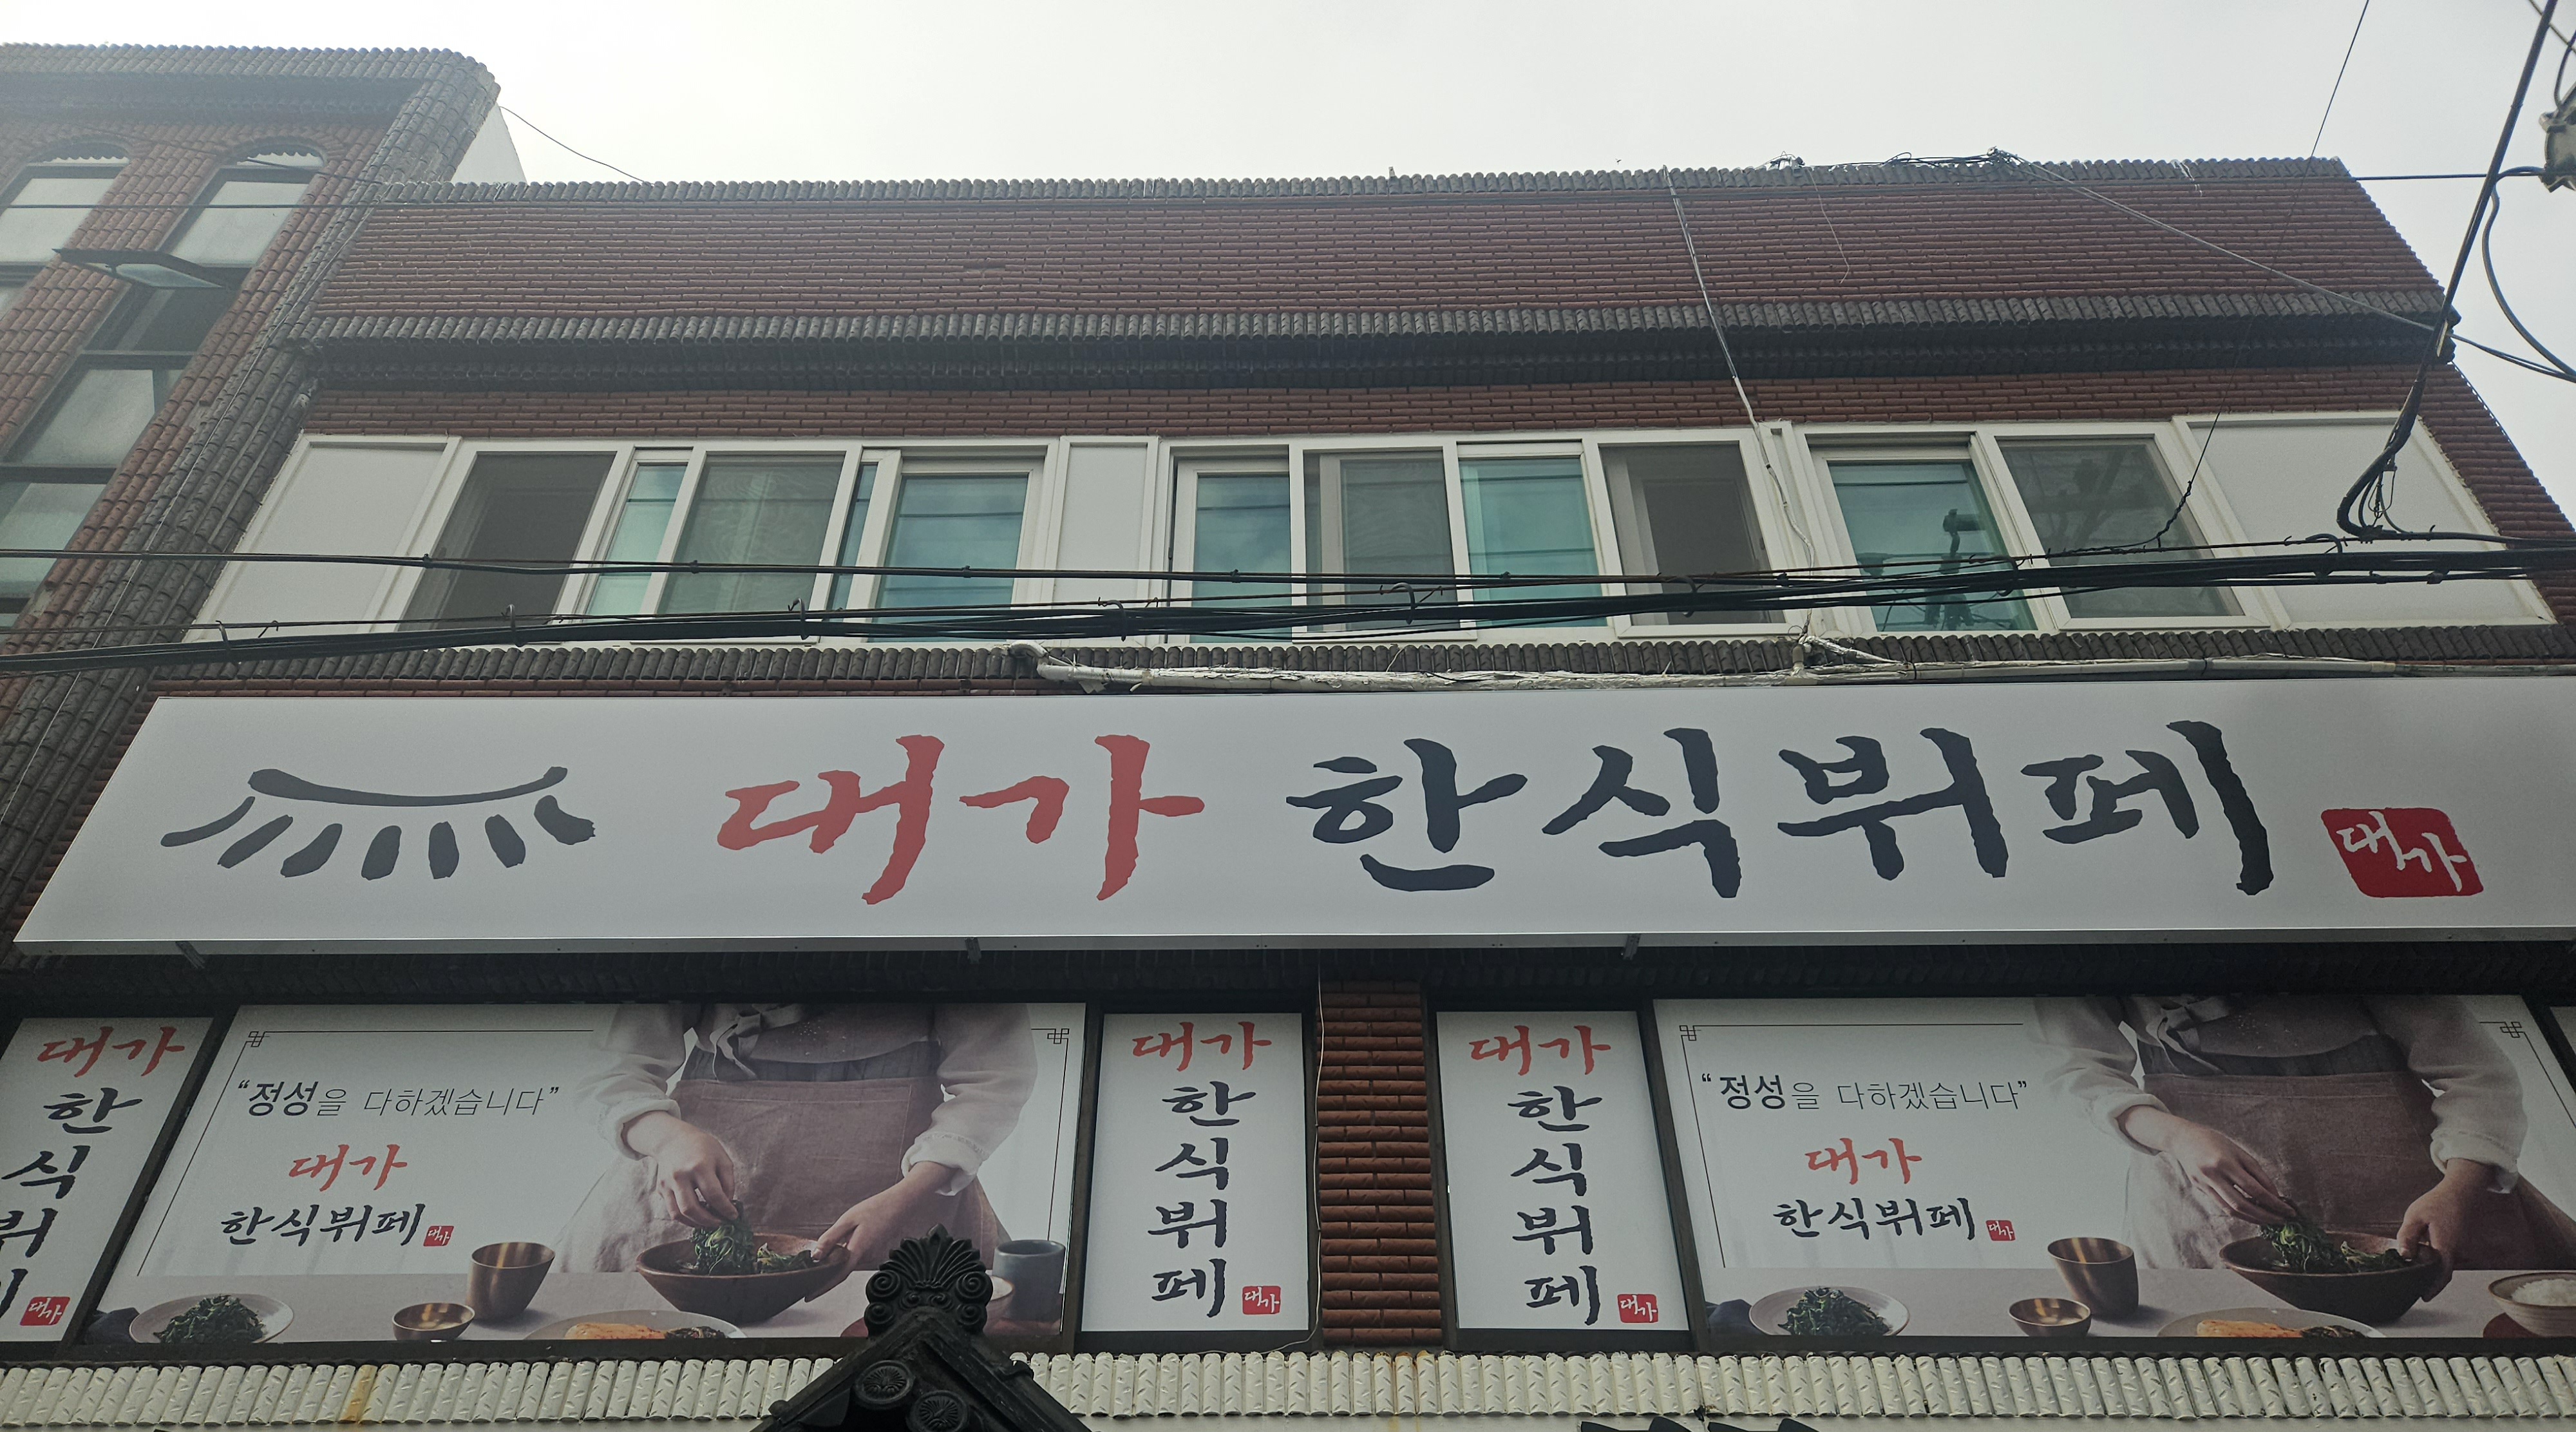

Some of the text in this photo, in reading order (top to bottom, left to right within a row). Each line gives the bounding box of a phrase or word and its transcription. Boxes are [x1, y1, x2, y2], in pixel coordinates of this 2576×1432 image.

[717, 720, 2275, 905] 대가 한식뷔페
[2336, 811, 2467, 892] 대가
[37, 1026, 185, 1078] 대가
[1132, 1021, 1272, 1072] 대가
[1469, 1024, 1611, 1076] 대가
[364, 1086, 560, 1116] 다하겠습니다”
[1837, 1080, 2027, 1110] 다하겠습니다”
[289, 1143, 408, 1192] 대가
[1804, 1138, 1922, 1185] 대가
[1148, 1080, 1257, 1318] 한식뷔페
[1507, 1085, 1603, 1326] 한식뷔페
[1772, 1198, 1976, 1240] 한식뷔페
[220, 1203, 426, 1246] 한식뷔페
[428, 1225, 450, 1245] 대가
[1987, 1220, 2014, 1241] 대가
[28, 1297, 62, 1324] 대가
[1244, 1286, 1280, 1313] 대가
[1620, 1294, 1657, 1322] 대가
